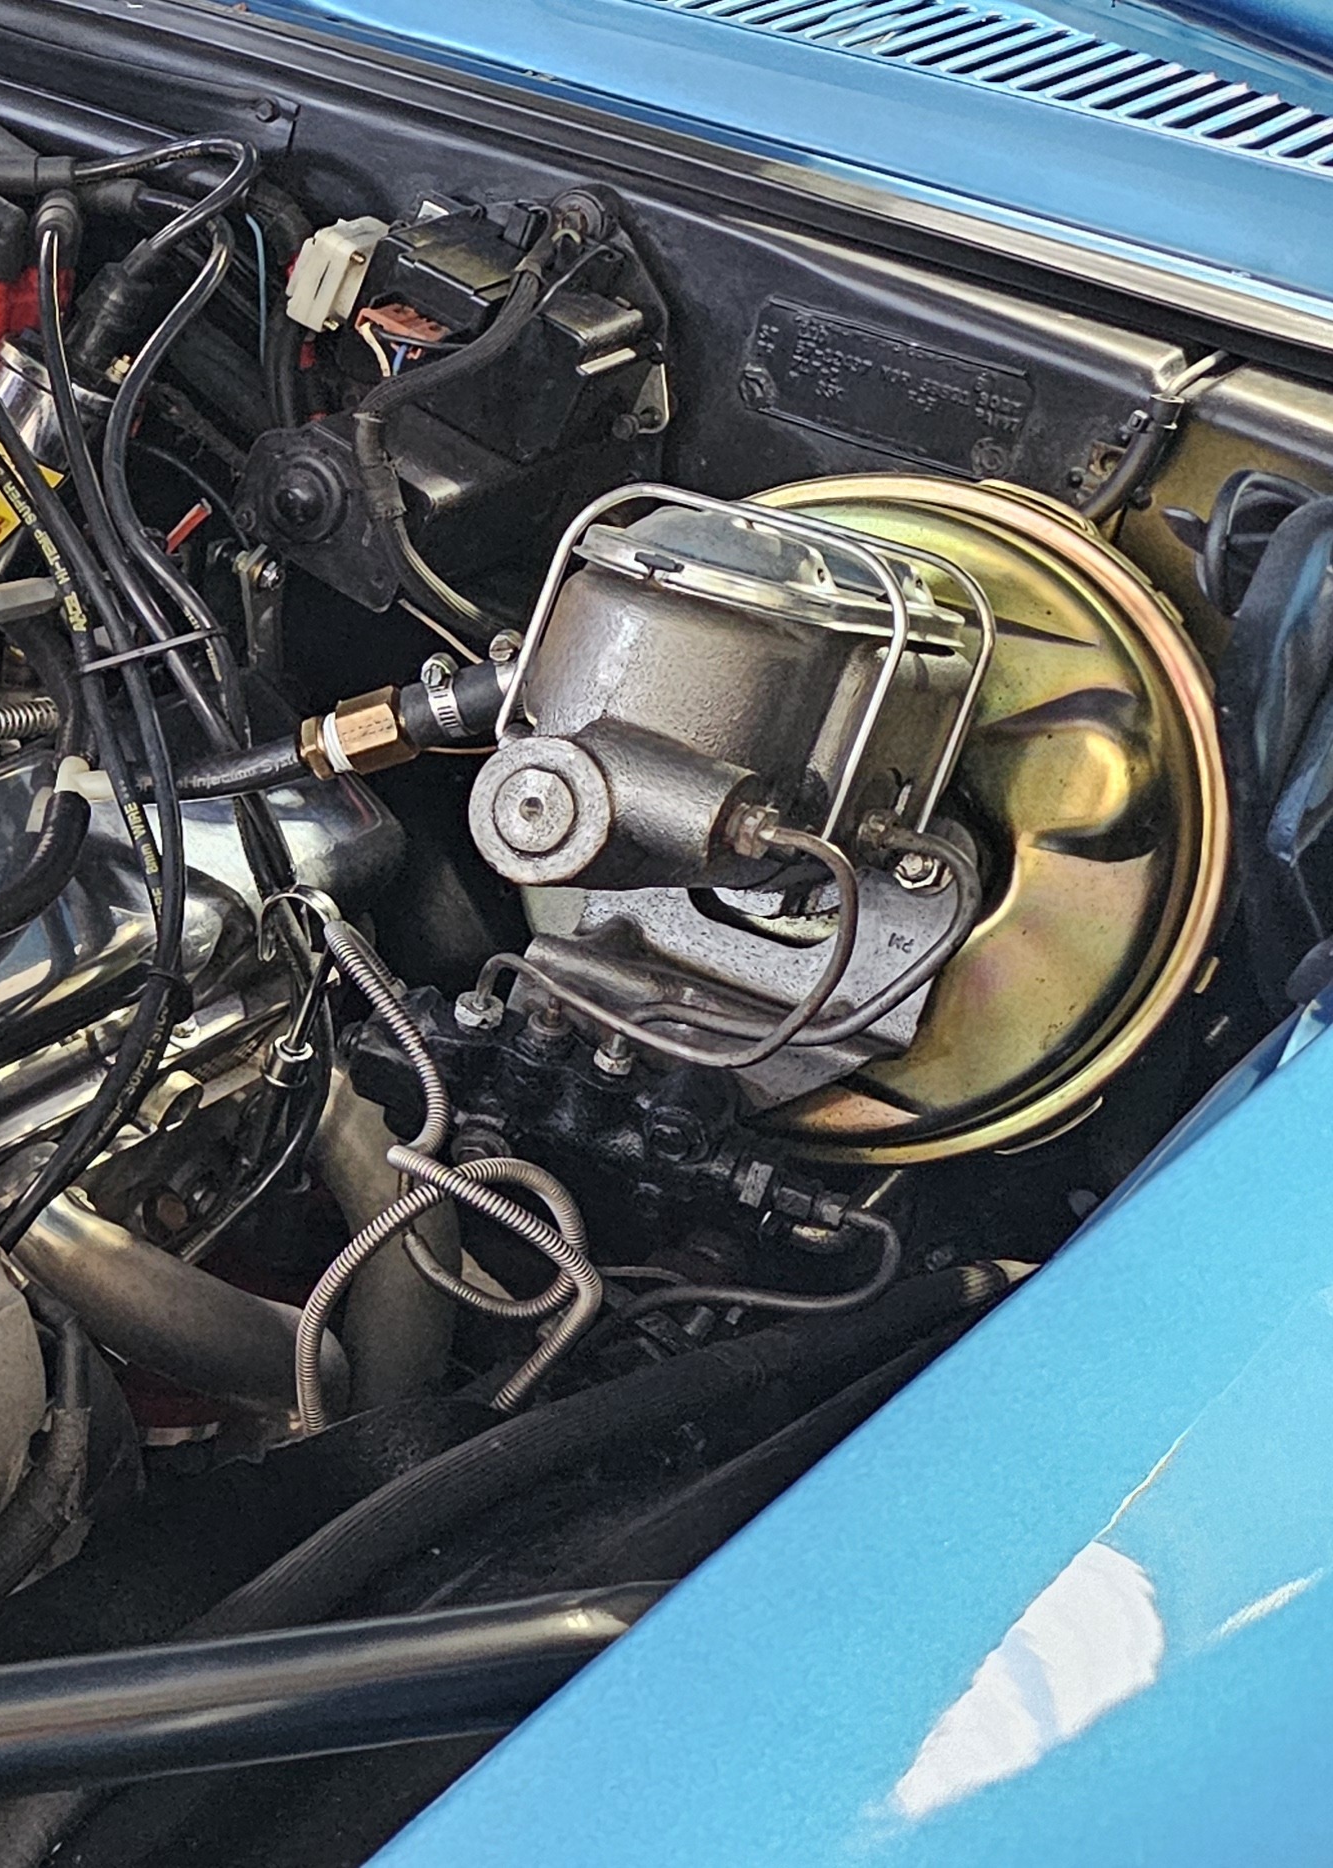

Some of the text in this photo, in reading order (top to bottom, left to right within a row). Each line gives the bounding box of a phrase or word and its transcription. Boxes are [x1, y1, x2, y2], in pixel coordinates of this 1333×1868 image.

[2, 479, 38, 526] SUPER
[123, 801, 146, 840] WIRE
[141, 843, 159, 875] 8mm
